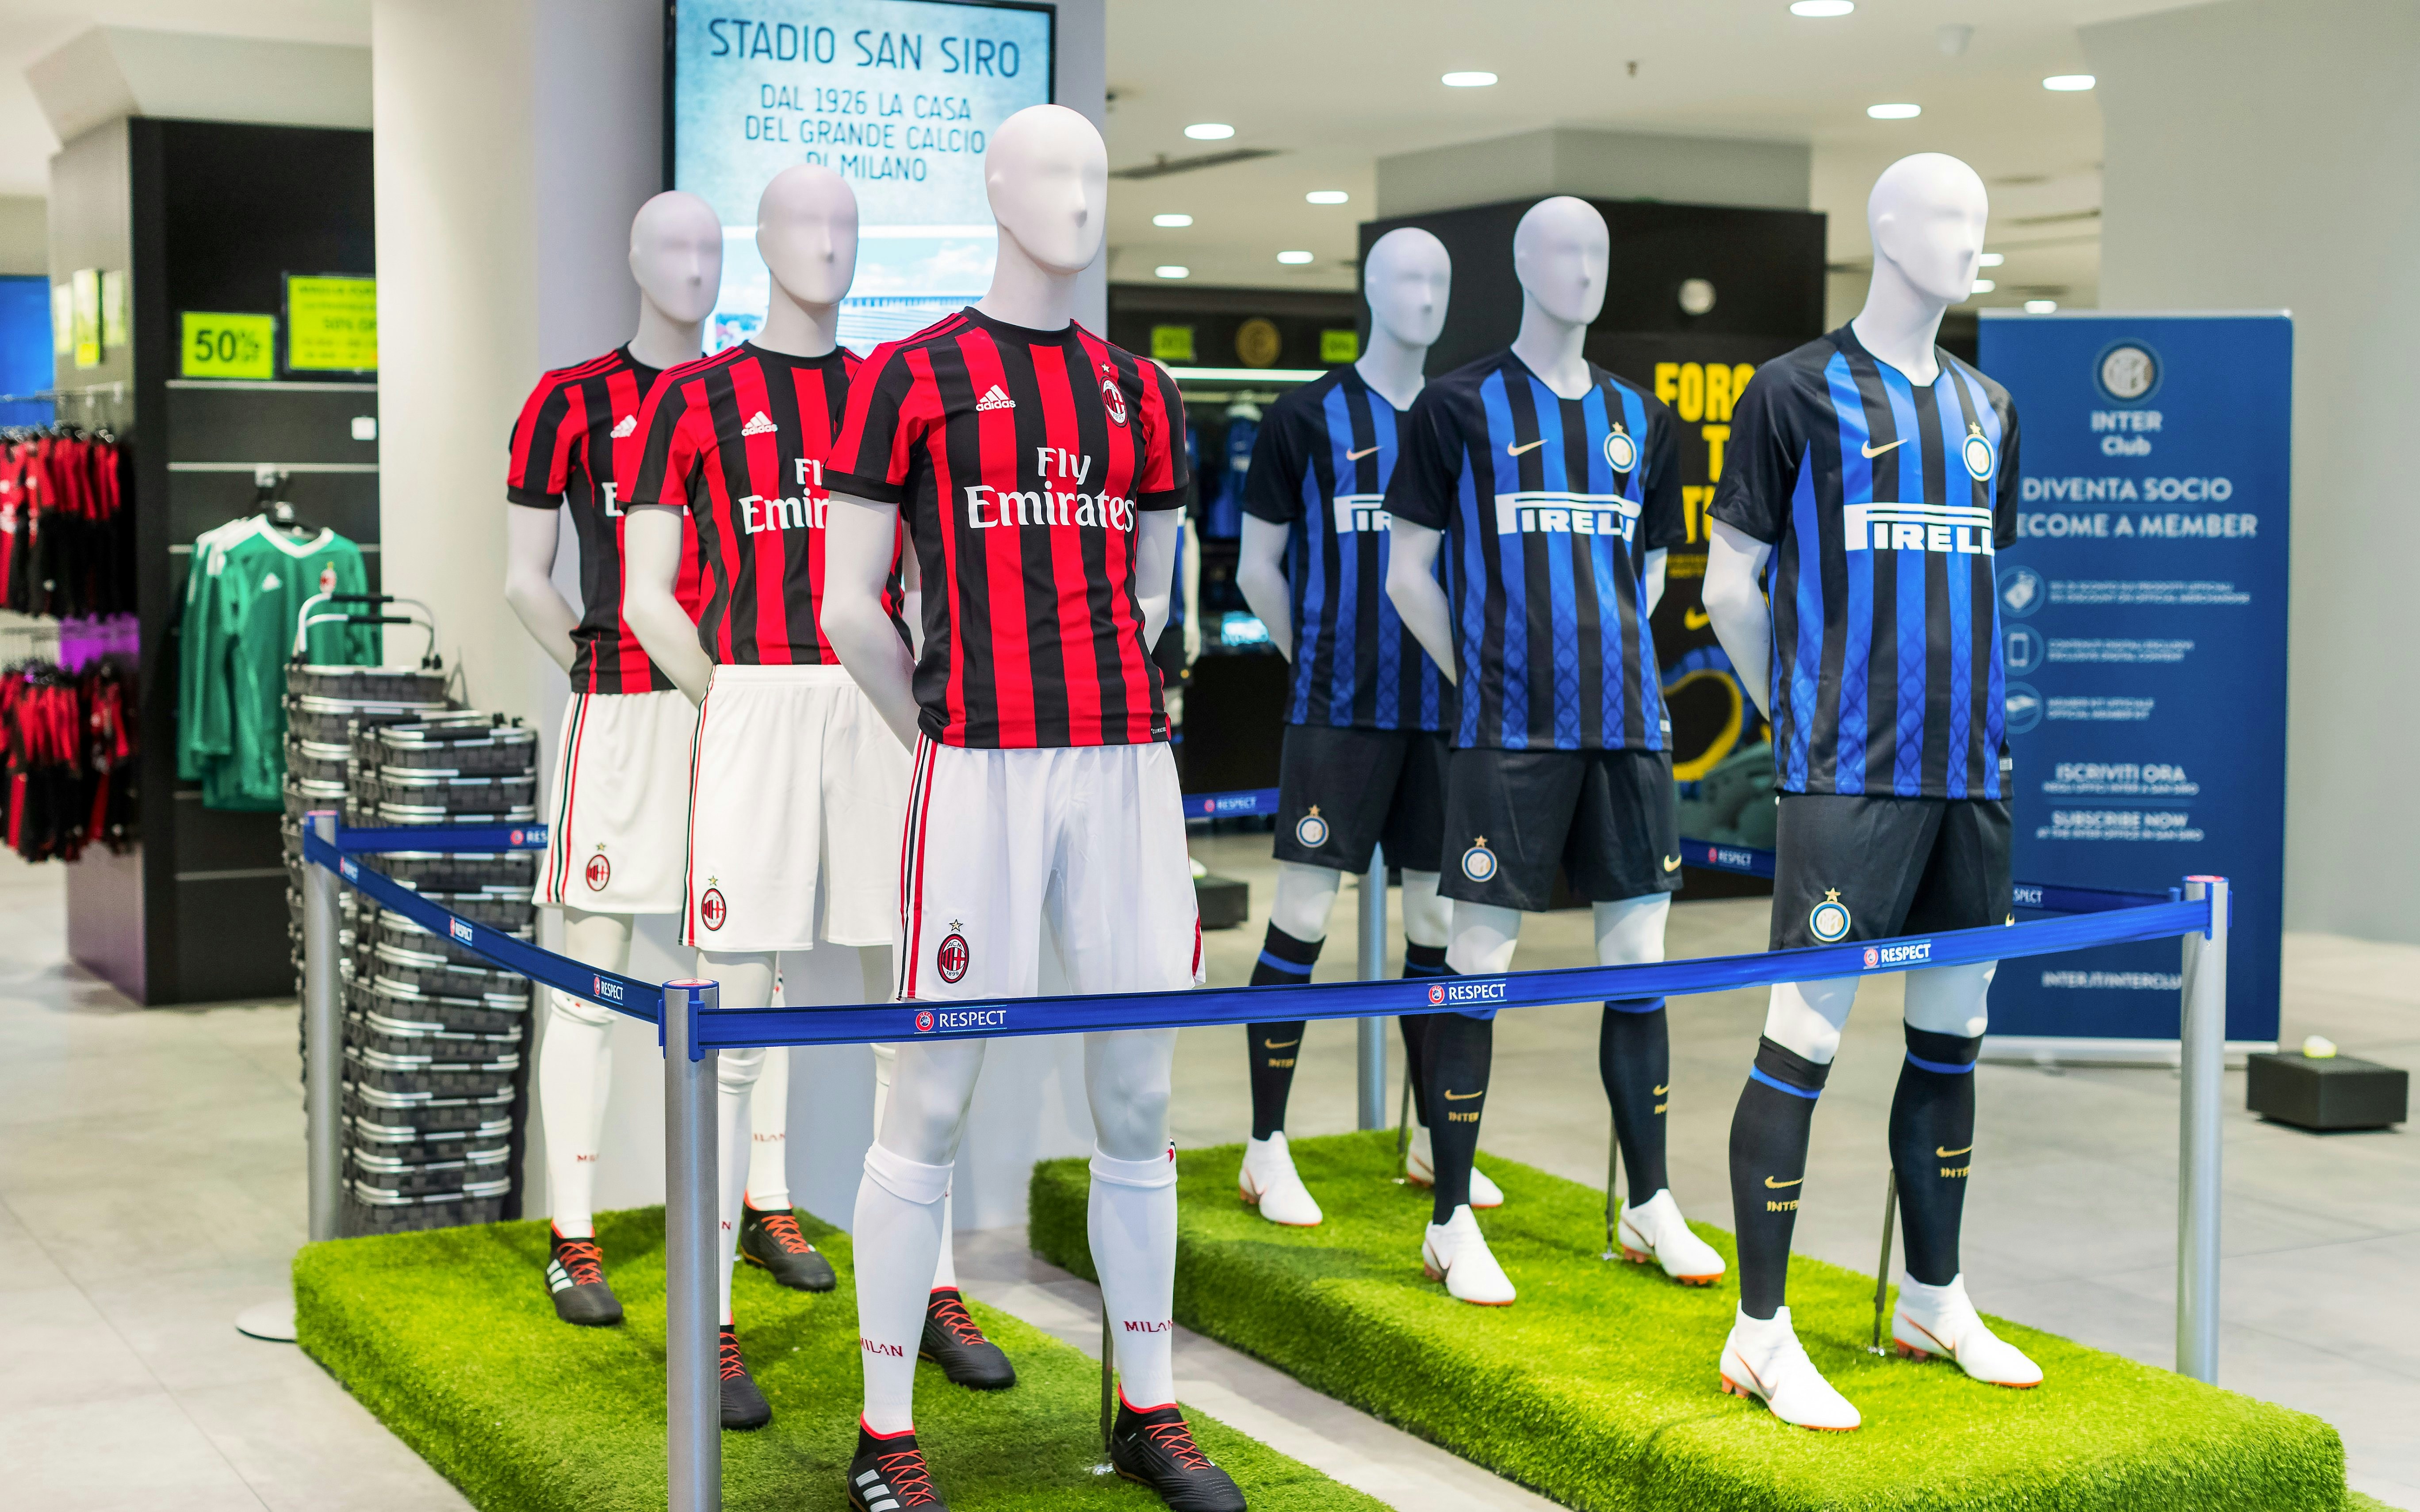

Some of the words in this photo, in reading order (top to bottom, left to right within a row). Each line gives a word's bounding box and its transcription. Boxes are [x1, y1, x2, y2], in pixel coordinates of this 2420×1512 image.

[709, 18, 835, 65] STADIO
[854, 30, 922, 71] SAN
[941, 36, 1020, 78] SIRO
[761, 84, 804, 112] DAL
[816, 87, 867, 115] 1926
[879, 92, 903, 117] LA
[914, 95, 972, 122] CASA
[745, 115, 789, 142] DEL
[800, 120, 894, 149] GRANDE
[906, 126, 985, 154] CALCIO
[841, 155, 927, 181] MILANO
[976, 399, 1016, 411] adidas
[741, 424, 778, 436] adidas
[2091, 411, 2163, 432] INTER
[2101, 435, 2152, 456] Club
[794, 458, 823, 486] Fl
[1037, 447, 1091, 485] Fly
[2022, 477, 2139, 502] DIVENTA
[2144, 477, 2233, 502] SOCIO
[739, 488, 829, 535] Emir
[964, 481, 1134, 533] Emirates
[1844, 502, 1995, 557] PIRELL
[2017, 513, 2110, 538] ECOME
[2114, 514, 2135, 538] A
[2140, 513, 2258, 538] MEMBER
[2013, 888, 2043, 903] SPECT
[946, 941, 962, 949] ACM
[1881, 943, 1931, 963] RESPECT
[601, 981, 623, 1000] RESPECT
[1449, 984, 1506, 1000] RESPECT
[939, 1010, 1006, 1027] RESPECT
[1940, 1166, 1970, 1178] INTE
[1767, 1200, 1798, 1212] INTE
